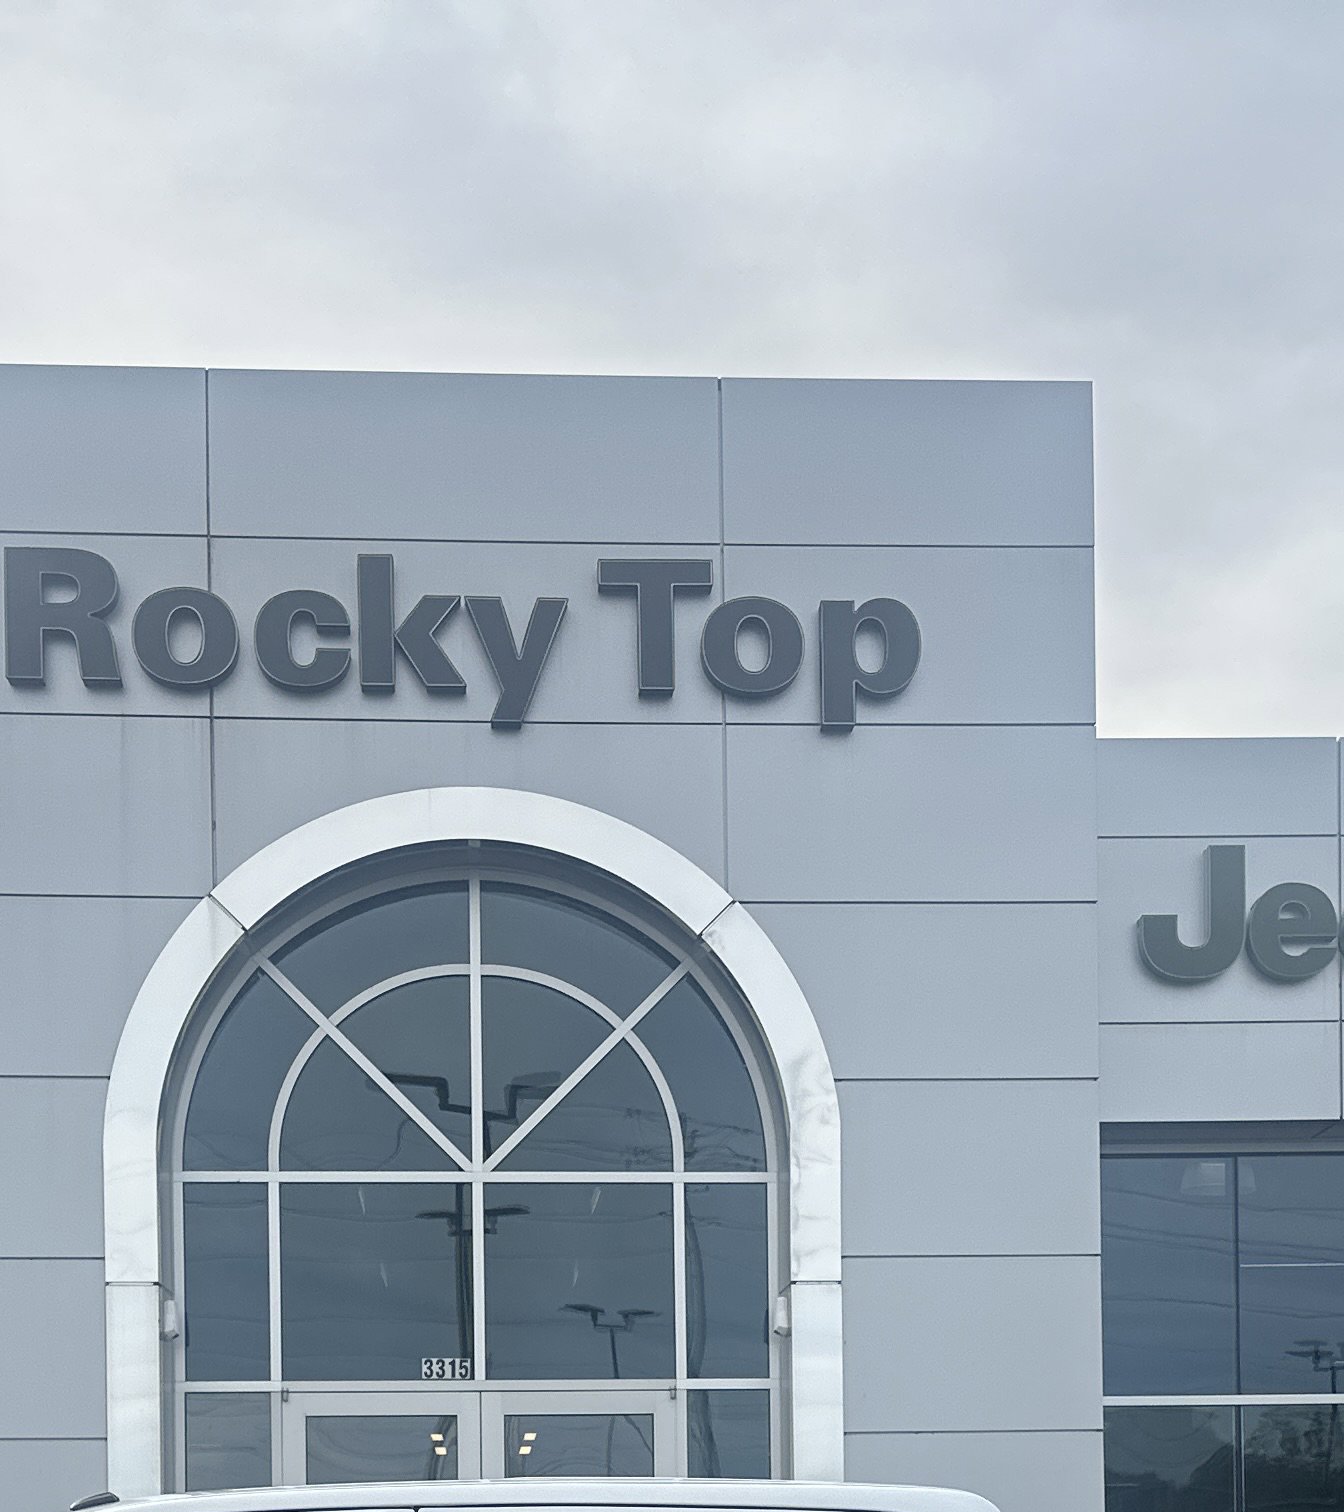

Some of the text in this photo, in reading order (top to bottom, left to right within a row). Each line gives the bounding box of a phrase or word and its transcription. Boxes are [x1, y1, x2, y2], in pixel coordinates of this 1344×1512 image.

[4, 546, 923, 733] Rocky Top
[423, 1358, 469, 1379] 3315
